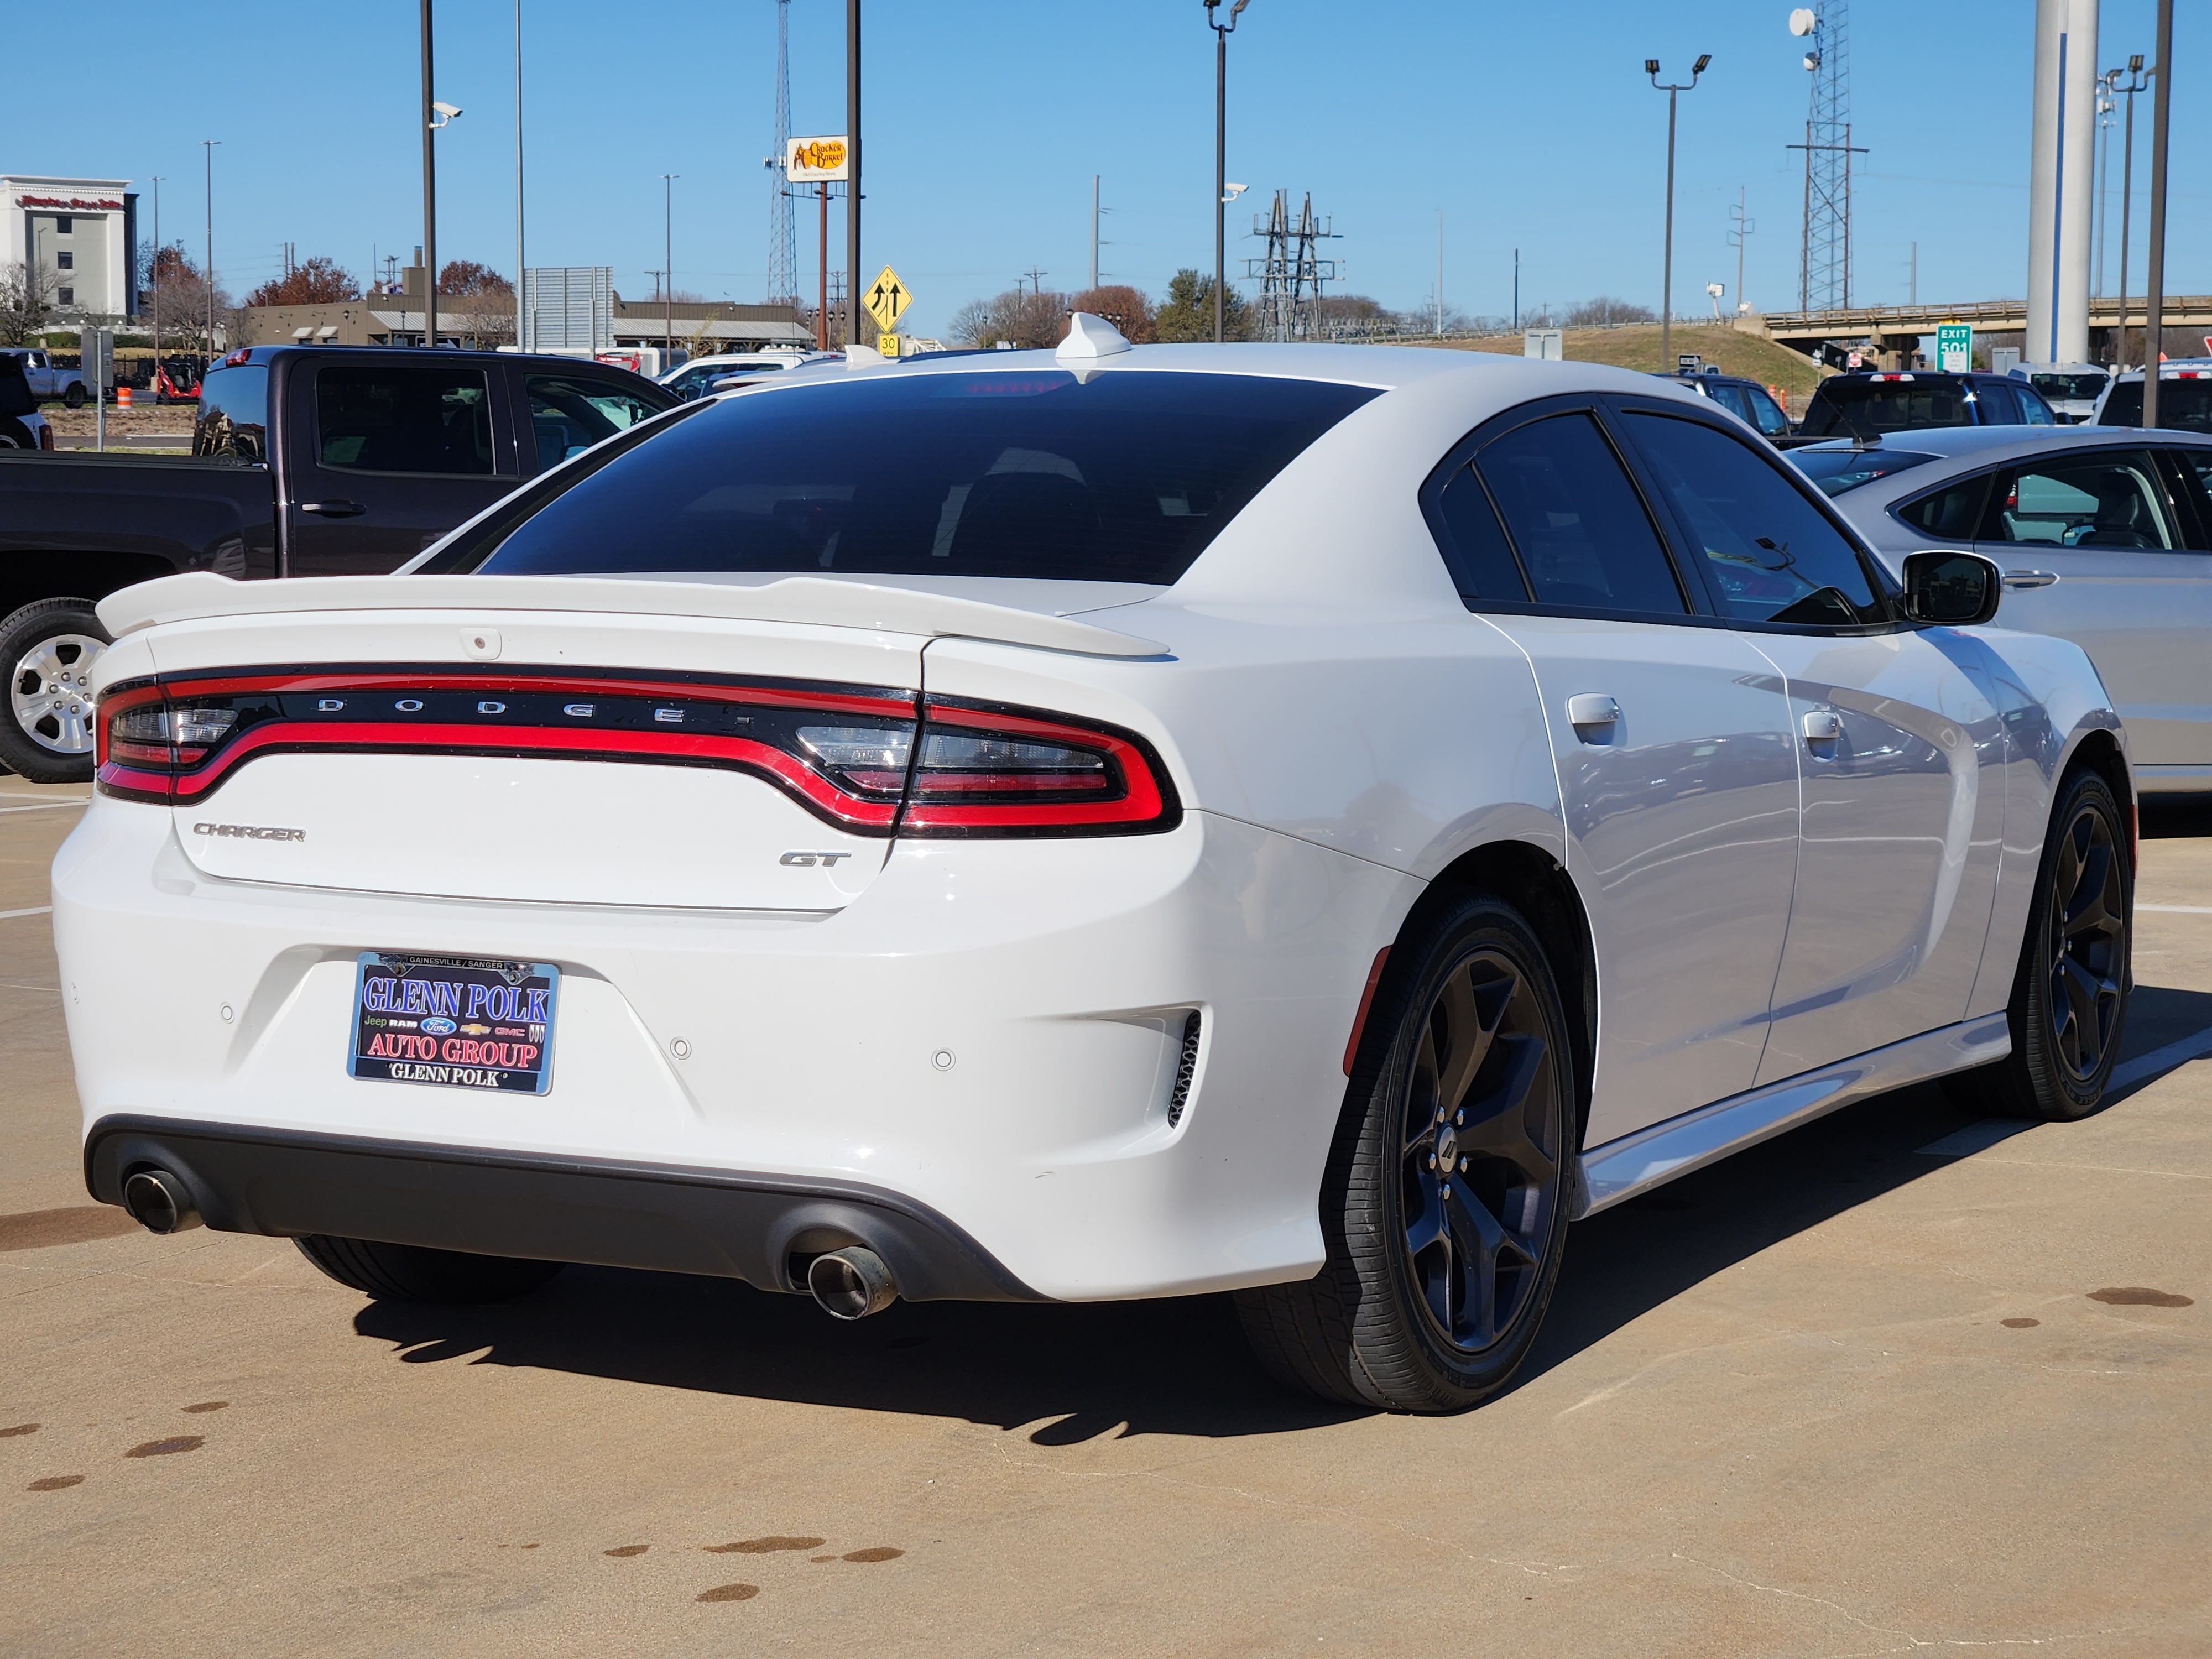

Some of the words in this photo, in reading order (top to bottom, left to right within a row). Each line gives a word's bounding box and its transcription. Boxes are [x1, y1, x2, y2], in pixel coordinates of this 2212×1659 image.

[810, 142, 841, 157] Cracker
[817, 151, 843, 168] Barrel
[1940, 329, 1968, 339] EXIT
[882, 338, 895, 349] 30
[1940, 342, 1968, 354] 501
[318, 698, 684, 723] DODGE
[193, 823, 306, 842] CHARGER
[779, 852, 852, 867] GT
[363, 977, 464, 1017] GLENN
[466, 984, 550, 1023] POLK
[364, 1015, 387, 1028] Jeep
[389, 1019, 418, 1028] RAM
[426, 1019, 450, 1032] Ford
[494, 1027, 525, 1036] GMC
[367, 1033, 437, 1060] AUTO
[442, 1038, 538, 1068] GROUP
[390, 1062, 450, 1083] GLENN
[451, 1068, 500, 1087] POLK
